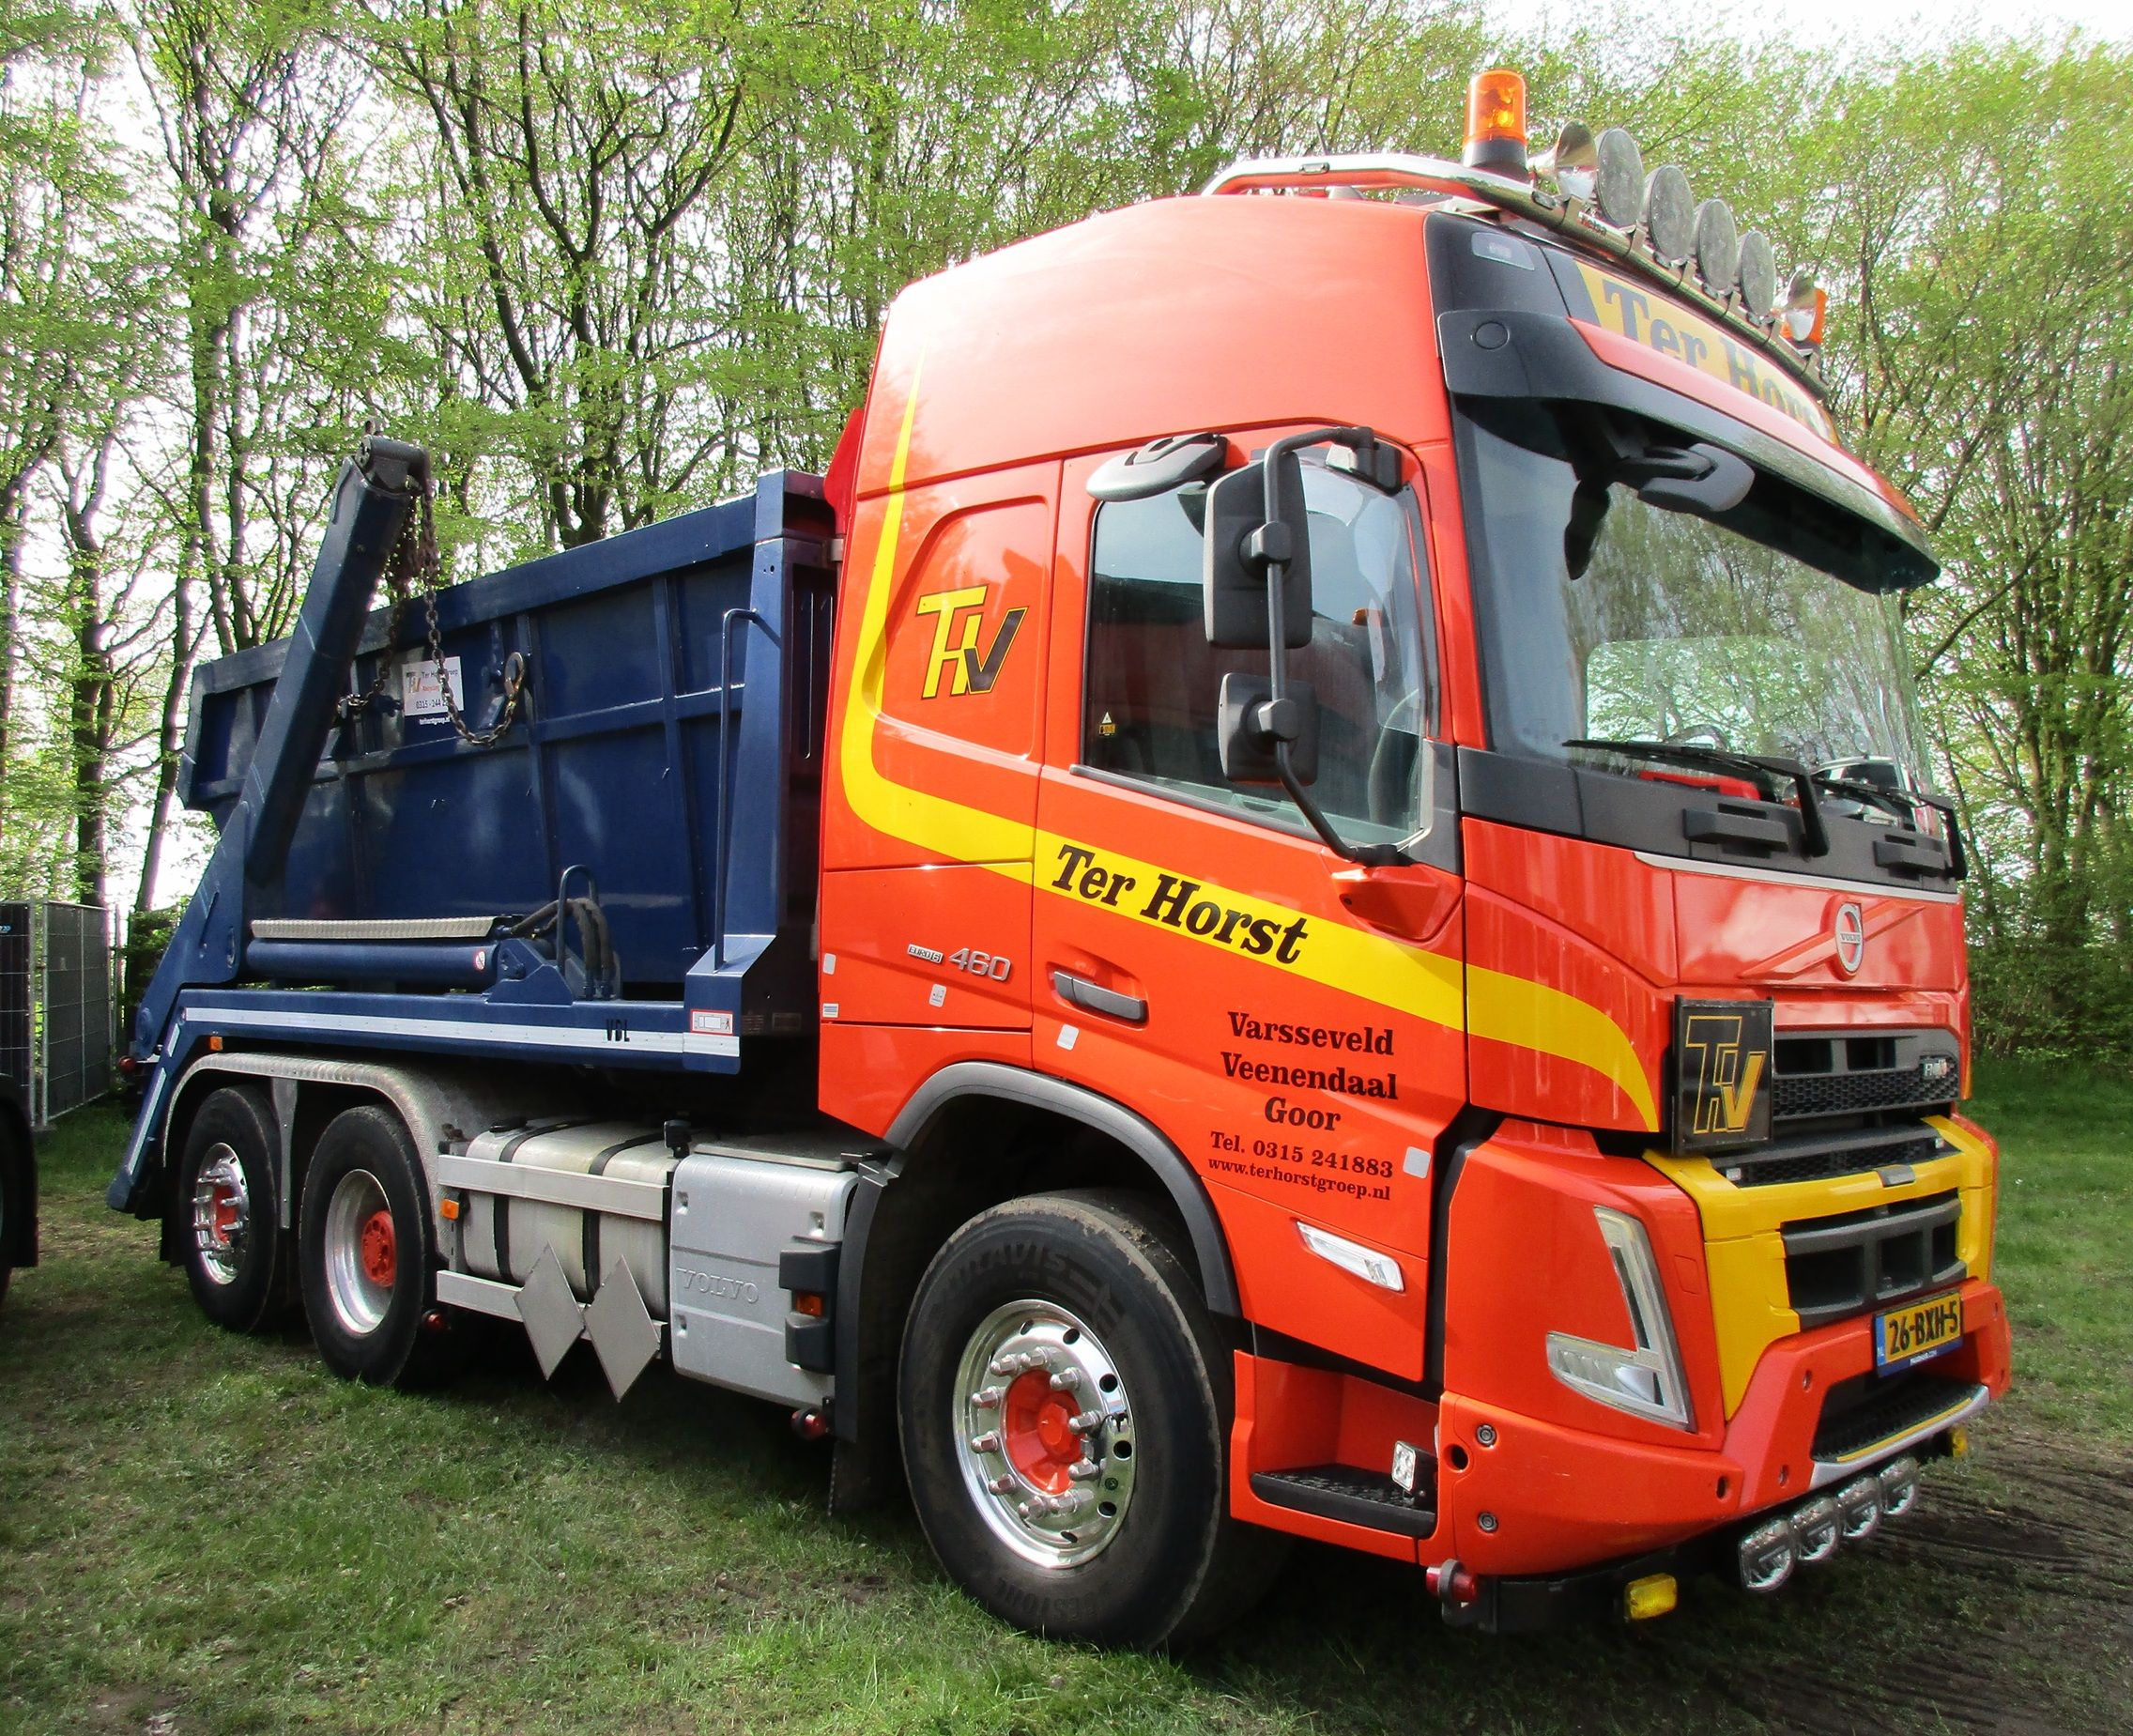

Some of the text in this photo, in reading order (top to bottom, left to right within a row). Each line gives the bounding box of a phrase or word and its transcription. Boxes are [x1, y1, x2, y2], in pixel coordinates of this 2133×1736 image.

[1602, 279, 1708, 368] Ter
[1051, 844, 1308, 964] Ter Horst
[949, 947, 1011, 981] 460
[606, 1019, 630, 1042] VDL
[1227, 1011, 1394, 1055] Varsseveld
[1220, 1052, 1398, 1099] Veenendaal
[1265, 1096, 1341, 1131] Goor
[1210, 1131, 1393, 1178] Tel. 0315 241883
[1208, 1158, 1390, 1200] www.terhorstgroep.nl
[676, 1267, 759, 1303] VOLVO
[1889, 1299, 1958, 1355] 26-BXH-5
